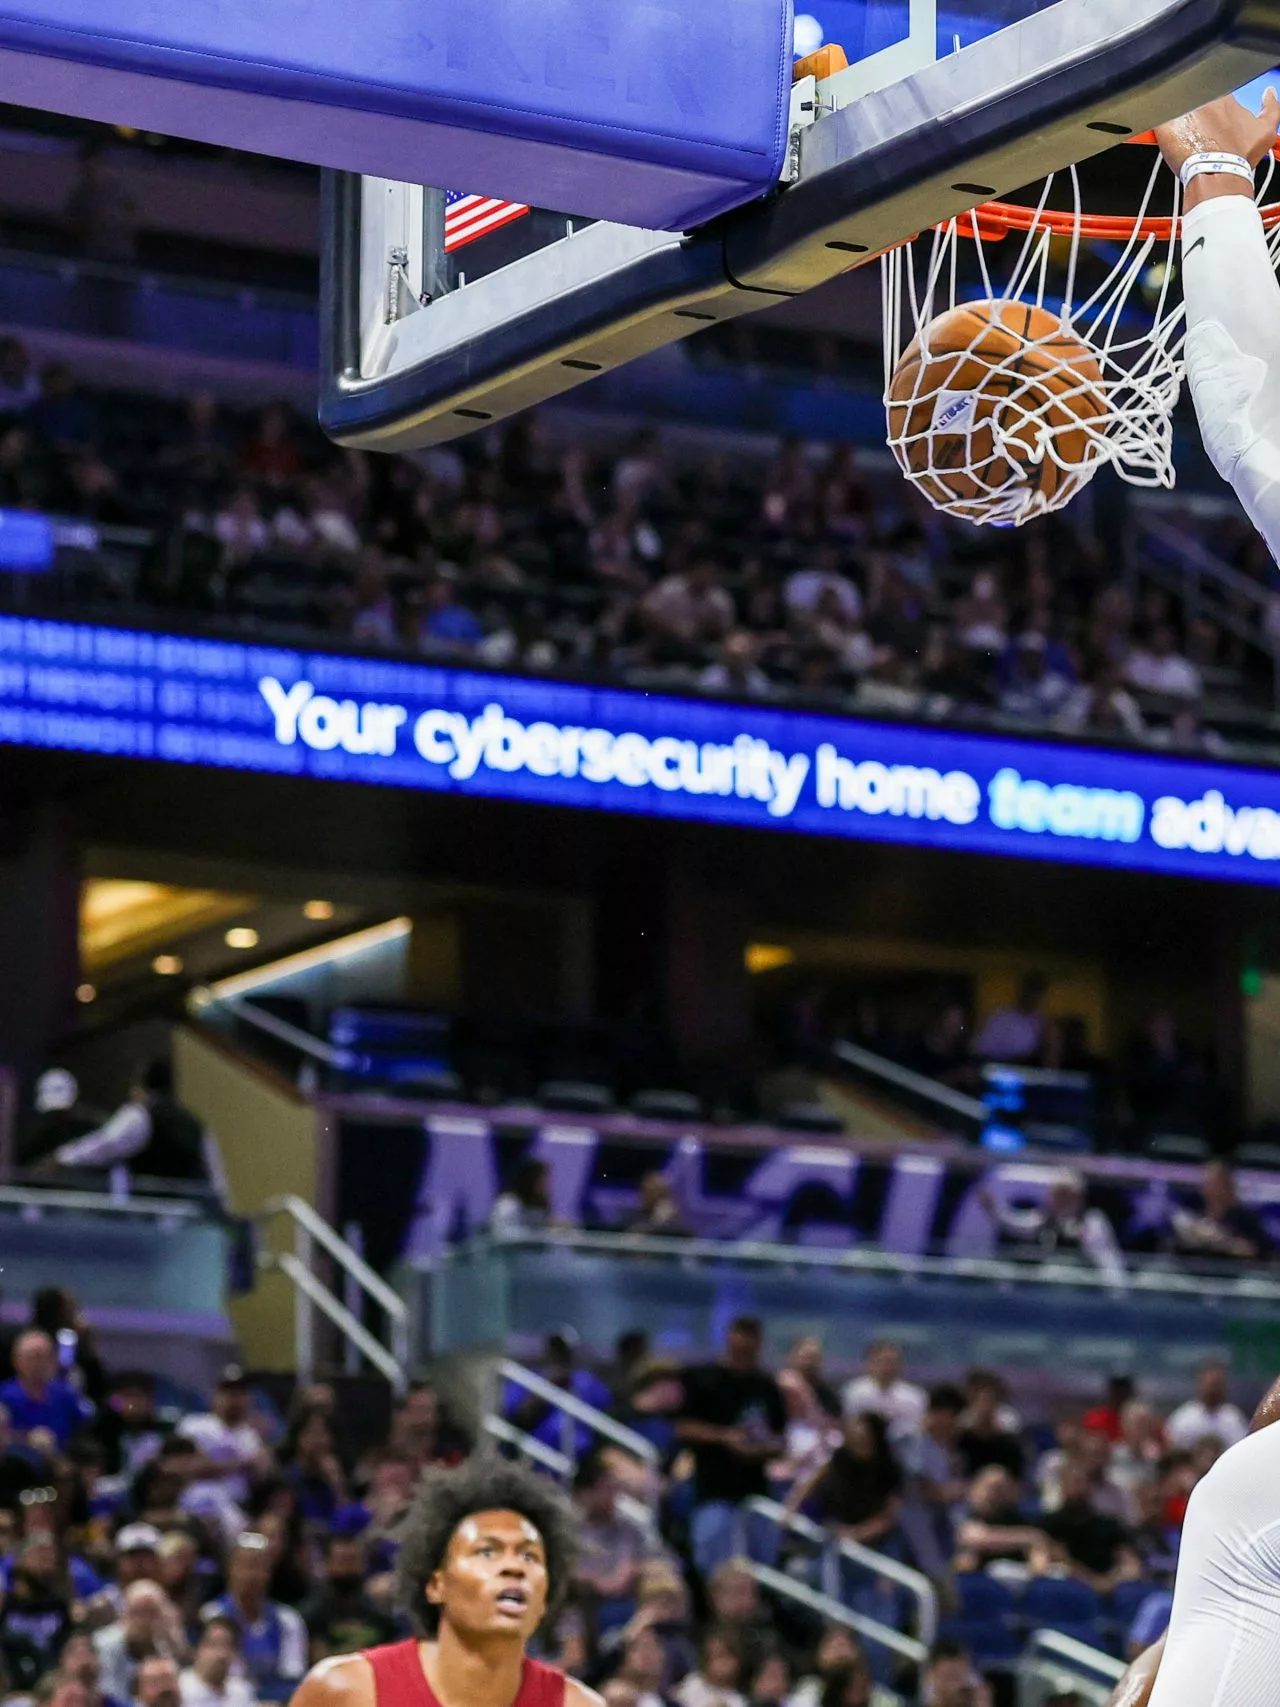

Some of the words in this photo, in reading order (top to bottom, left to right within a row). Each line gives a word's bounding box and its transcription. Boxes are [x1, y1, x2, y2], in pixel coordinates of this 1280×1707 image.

[258, 676, 406, 757] Your
[413, 702, 810, 817] cybersecurity
[816, 744, 981, 825] home
[987, 767, 1145, 843] team
